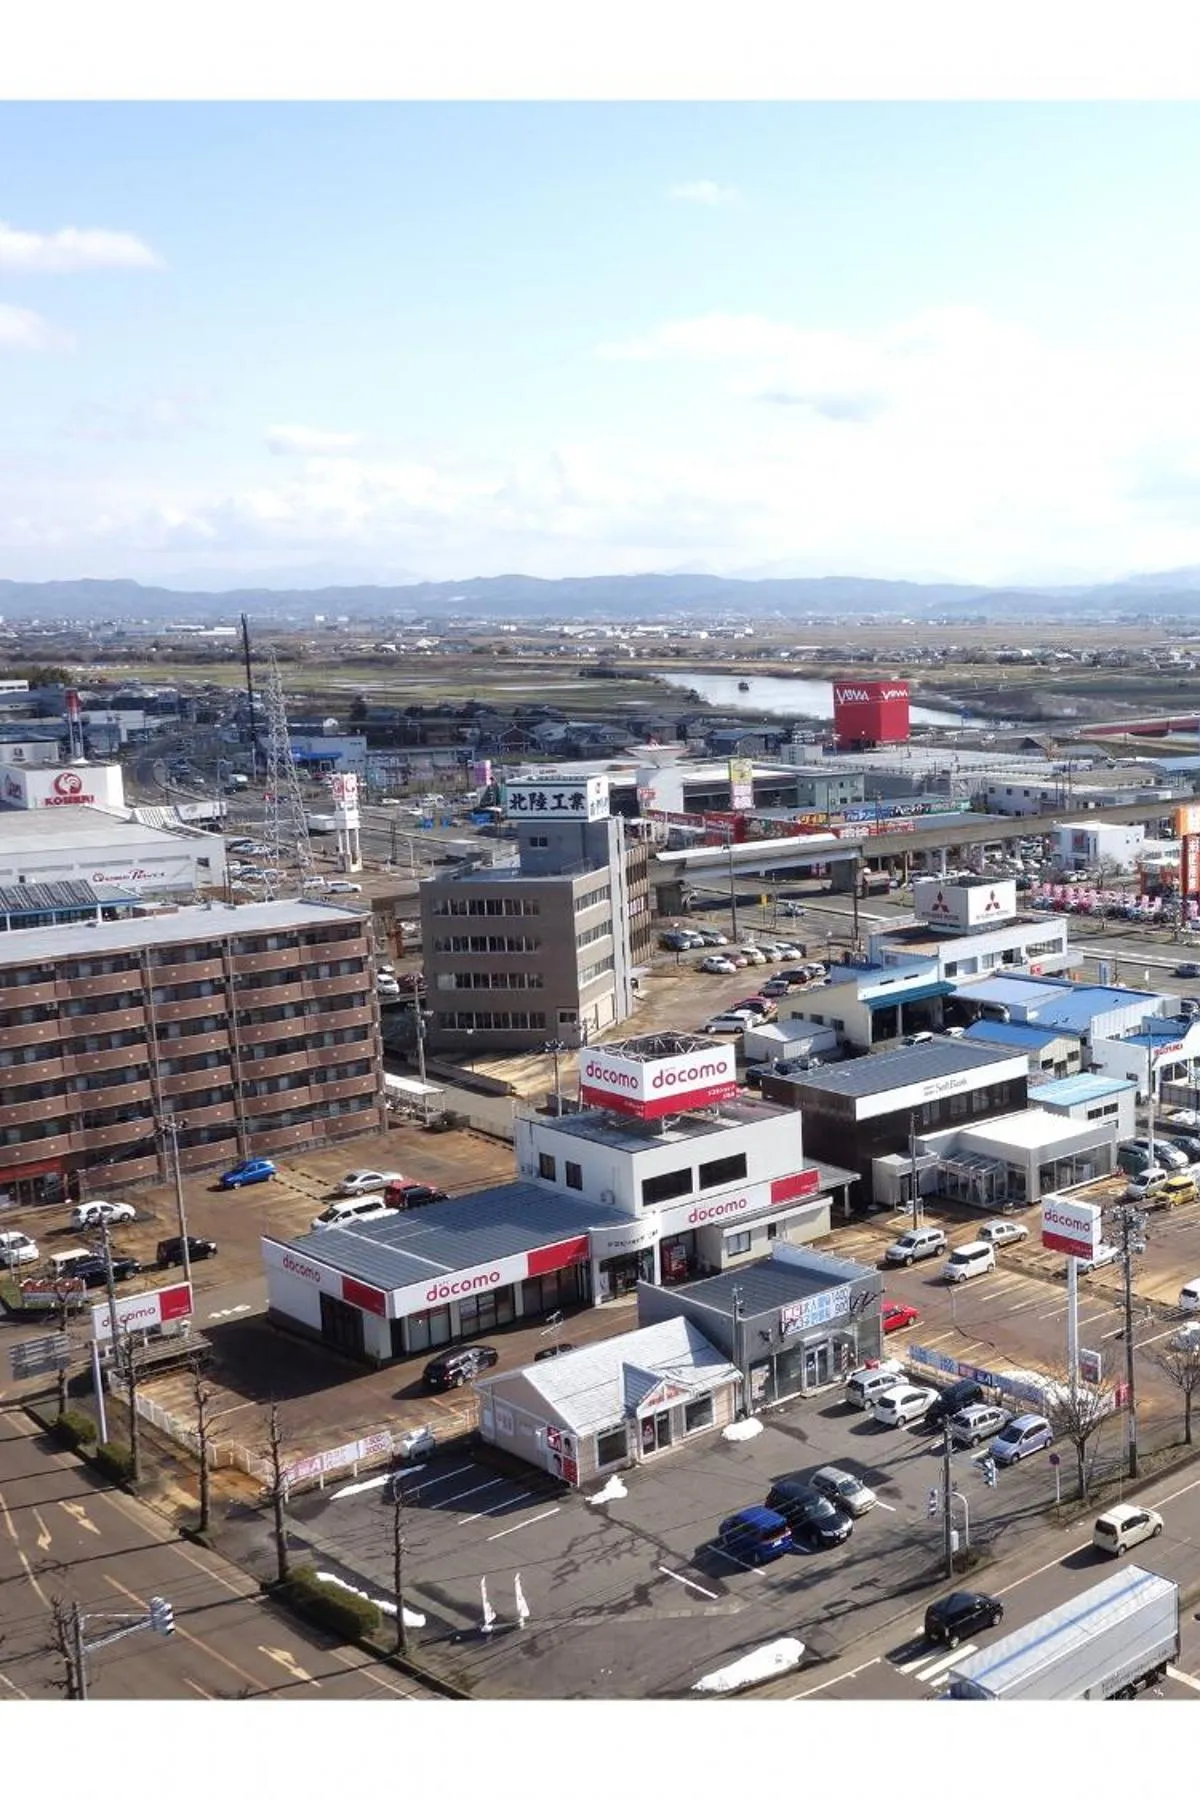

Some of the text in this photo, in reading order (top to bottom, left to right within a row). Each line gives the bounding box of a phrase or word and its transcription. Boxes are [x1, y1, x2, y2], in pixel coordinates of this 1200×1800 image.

[509, 791, 586, 811] 北陸工業
[586, 1061, 639, 1089] docomo
[652, 1061, 727, 1089] docomo
[688, 1197, 747, 1224] docomo
[1044, 1208, 1090, 1232] docomo
[282, 1254, 321, 1283] docomo
[426, 1271, 500, 1303] docomo
[102, 1306, 156, 1328] dcomo
